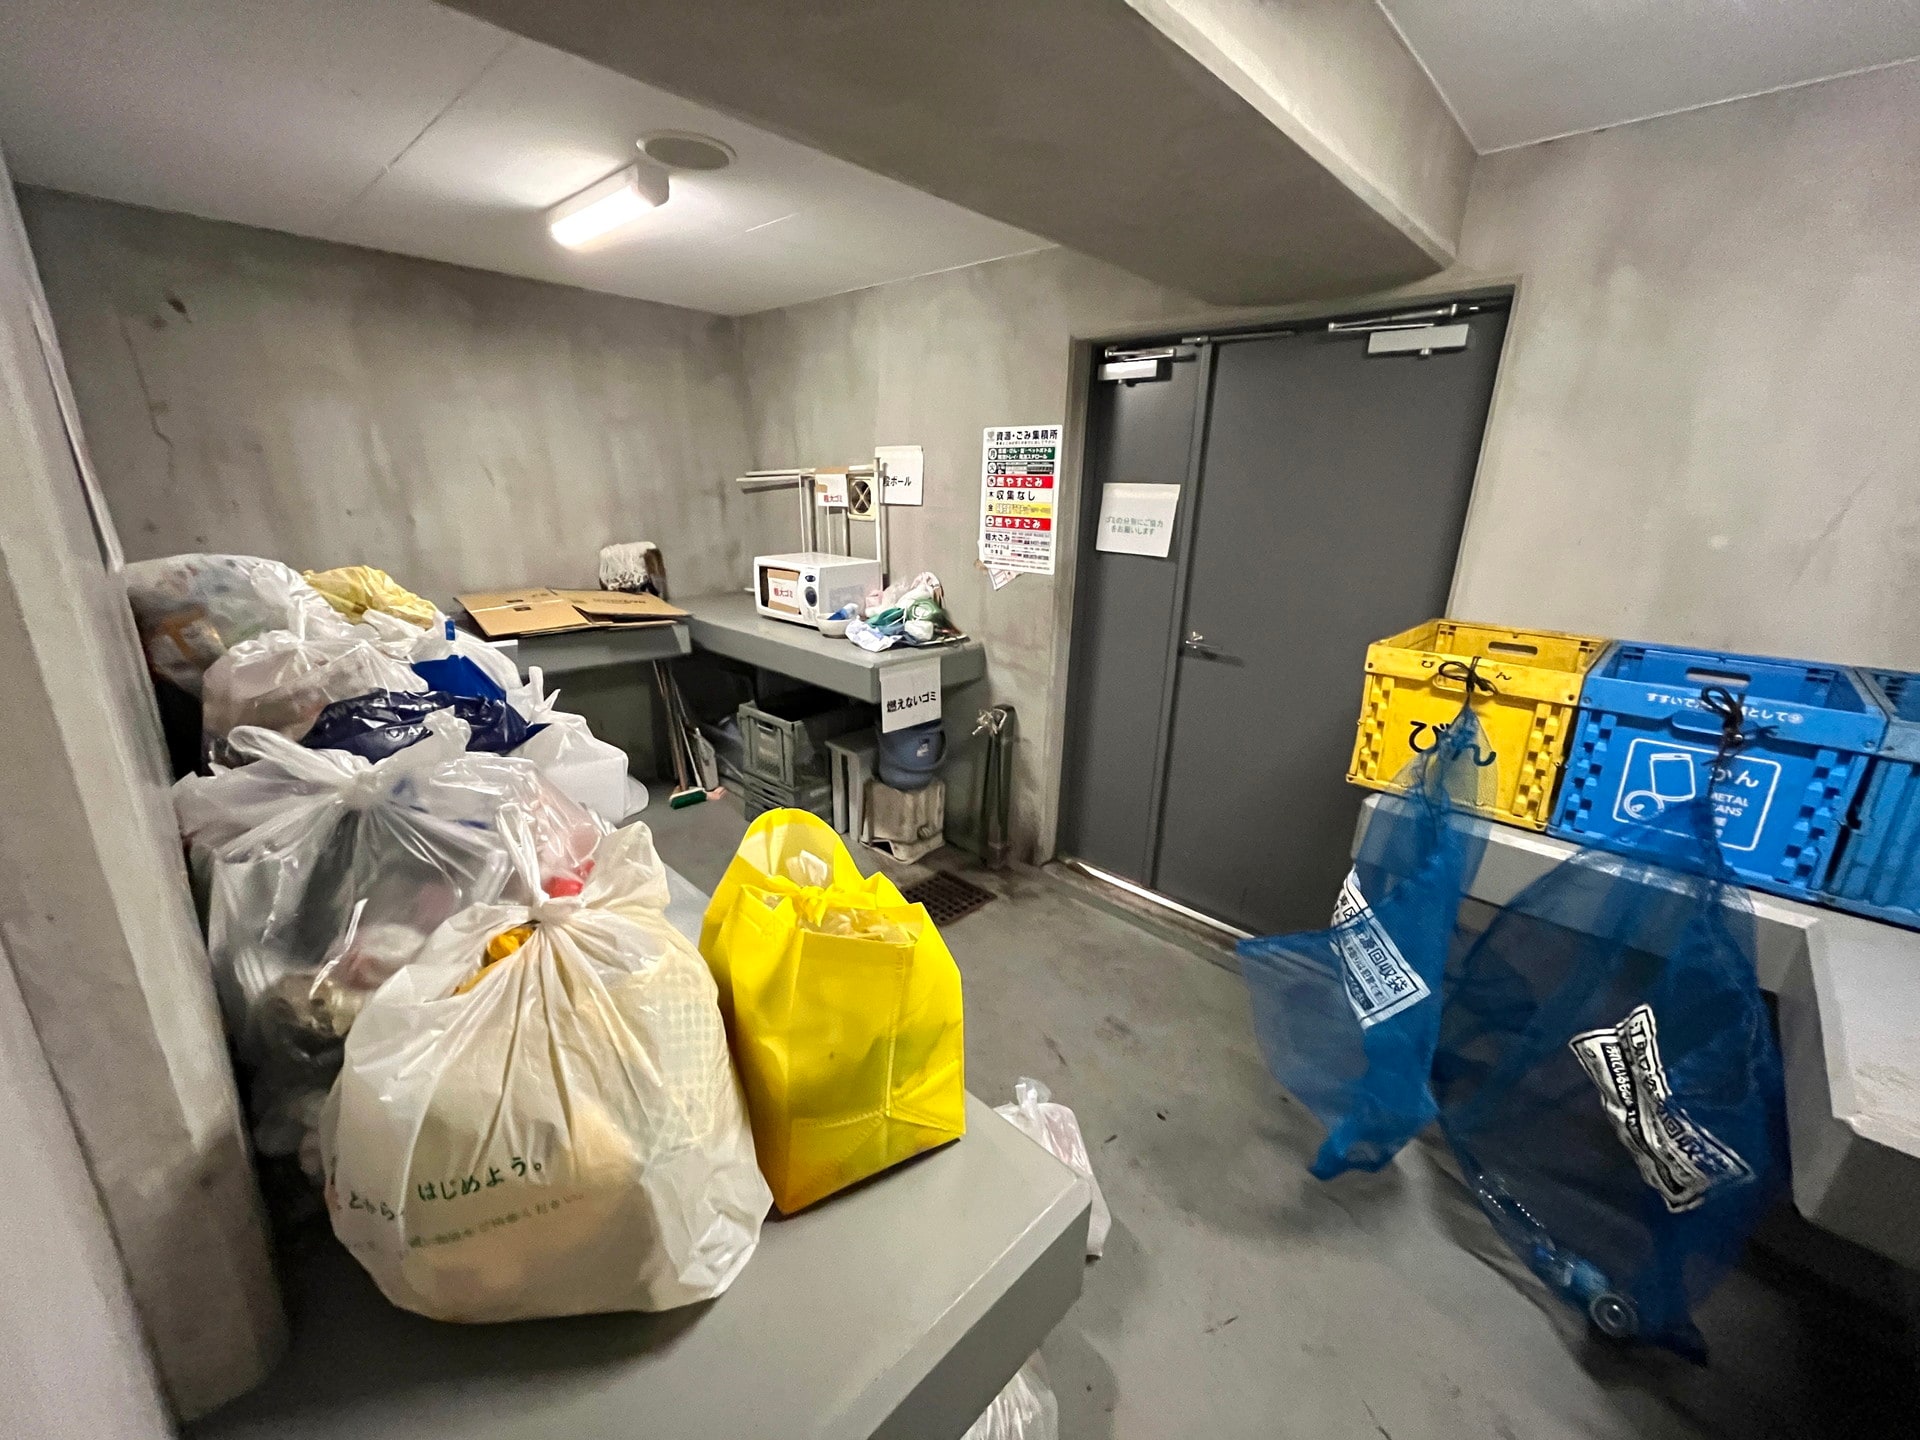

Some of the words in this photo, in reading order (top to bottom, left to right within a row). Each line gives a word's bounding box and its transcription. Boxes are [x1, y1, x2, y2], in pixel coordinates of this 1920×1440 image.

[996, 429, 1058, 441] 資源・ごみ集積所
[996, 476, 1043, 487] 燃やすごみ
[996, 490, 1036, 501] 収集なし
[995, 516, 1041, 529] 燃やすごみ
[1111, 525, 1156, 536] をお願いします
[886, 691, 937, 713] 燃えないゴミ
[1711, 803, 1744, 818] ANS
[417, 1156, 543, 1201] はじめよう。
